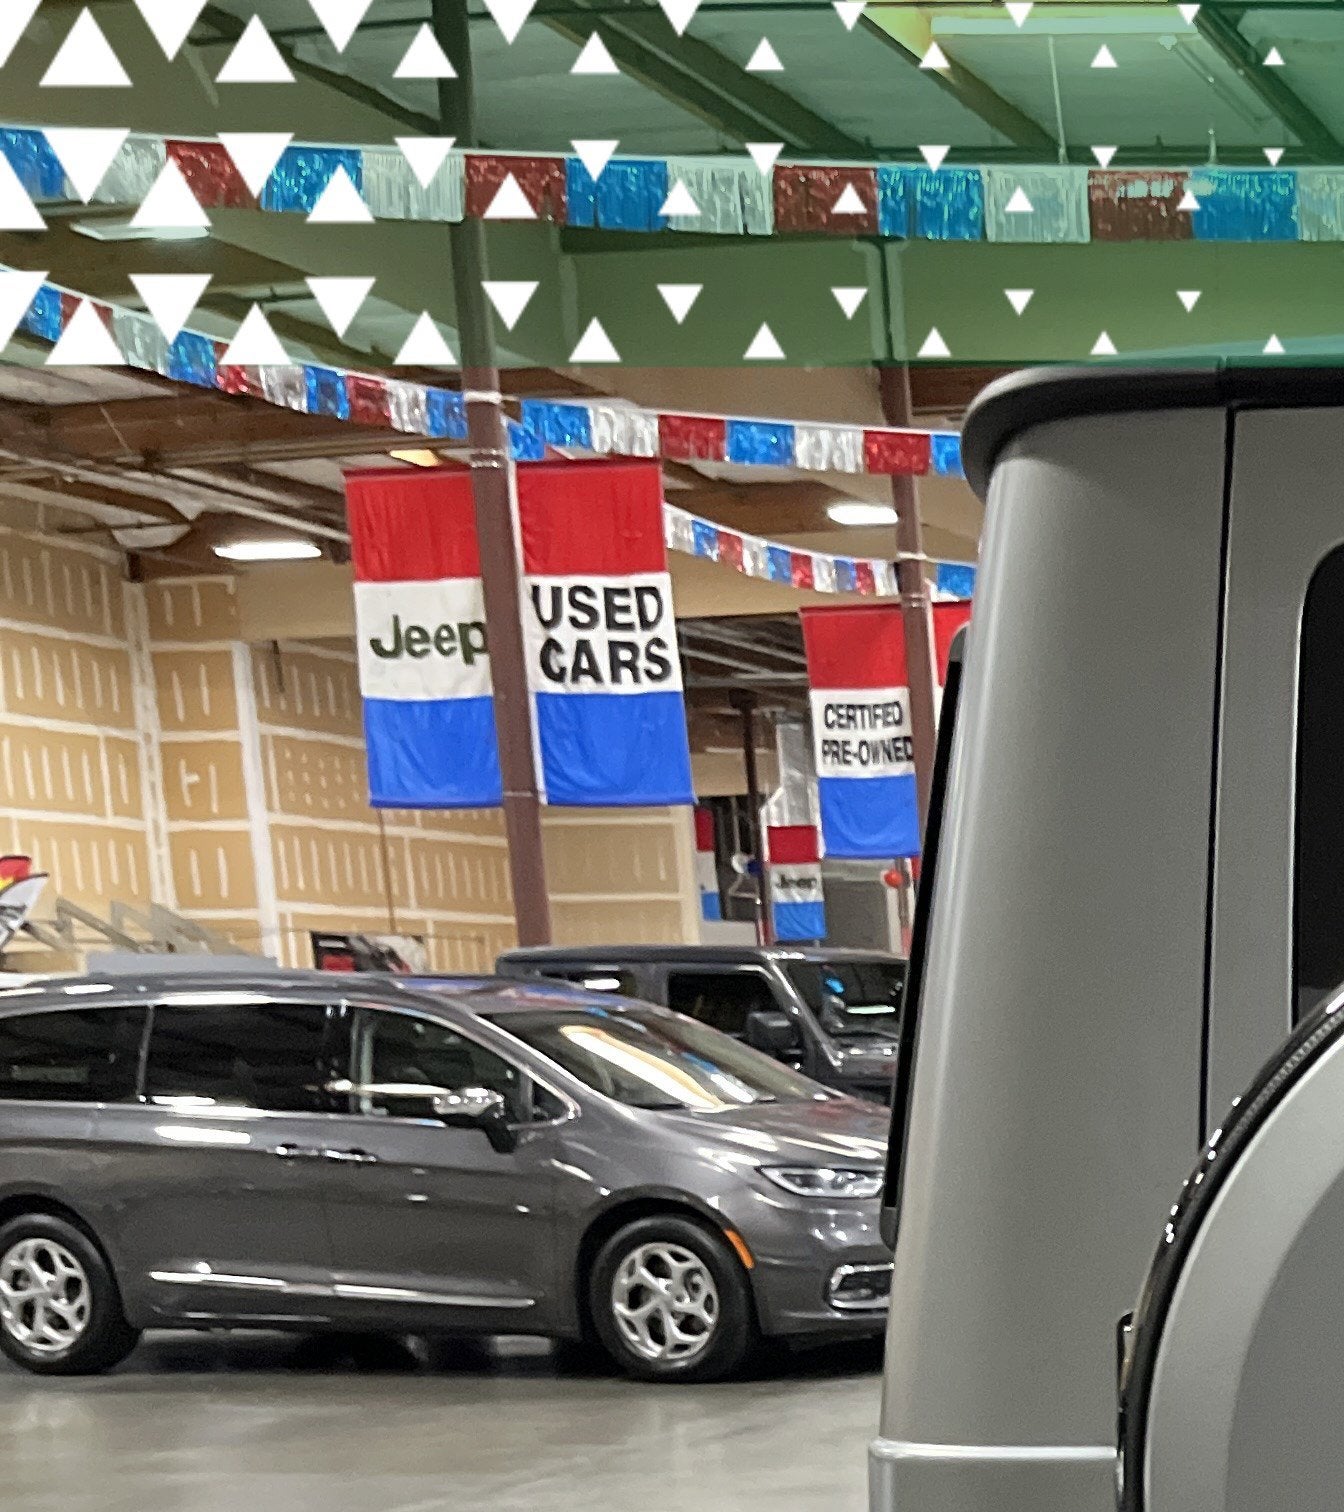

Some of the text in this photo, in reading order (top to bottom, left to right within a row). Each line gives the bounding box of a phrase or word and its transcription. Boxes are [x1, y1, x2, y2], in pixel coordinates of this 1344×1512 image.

[530, 585, 663, 632] USED
[369, 614, 489, 665] Jeep
[539, 636, 673, 684] CARS
[821, 735, 914, 766] PRE-OWNED
